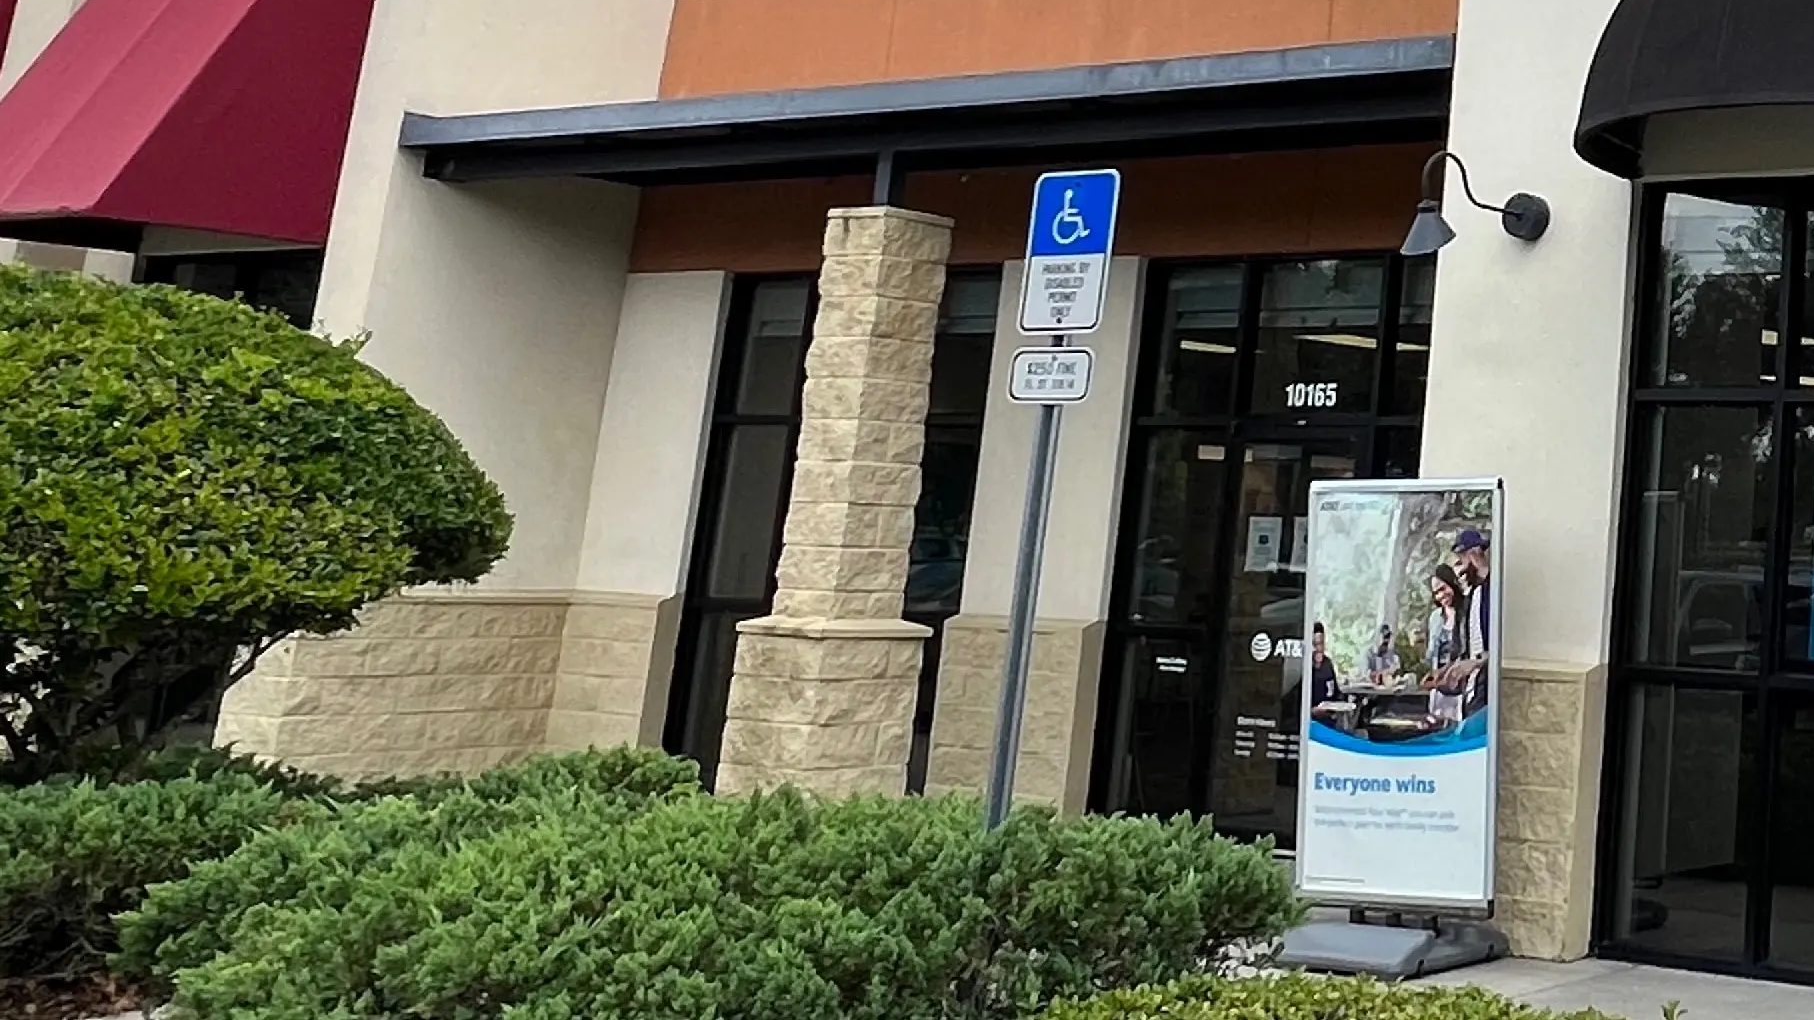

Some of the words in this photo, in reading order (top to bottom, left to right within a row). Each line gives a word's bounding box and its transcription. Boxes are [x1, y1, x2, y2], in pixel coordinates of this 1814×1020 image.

[1285, 382, 1338, 408] 10165
[1273, 639, 1303, 658] AT&
[1314, 772, 1391, 795] Everyone
[1395, 774, 1436, 794] wins
